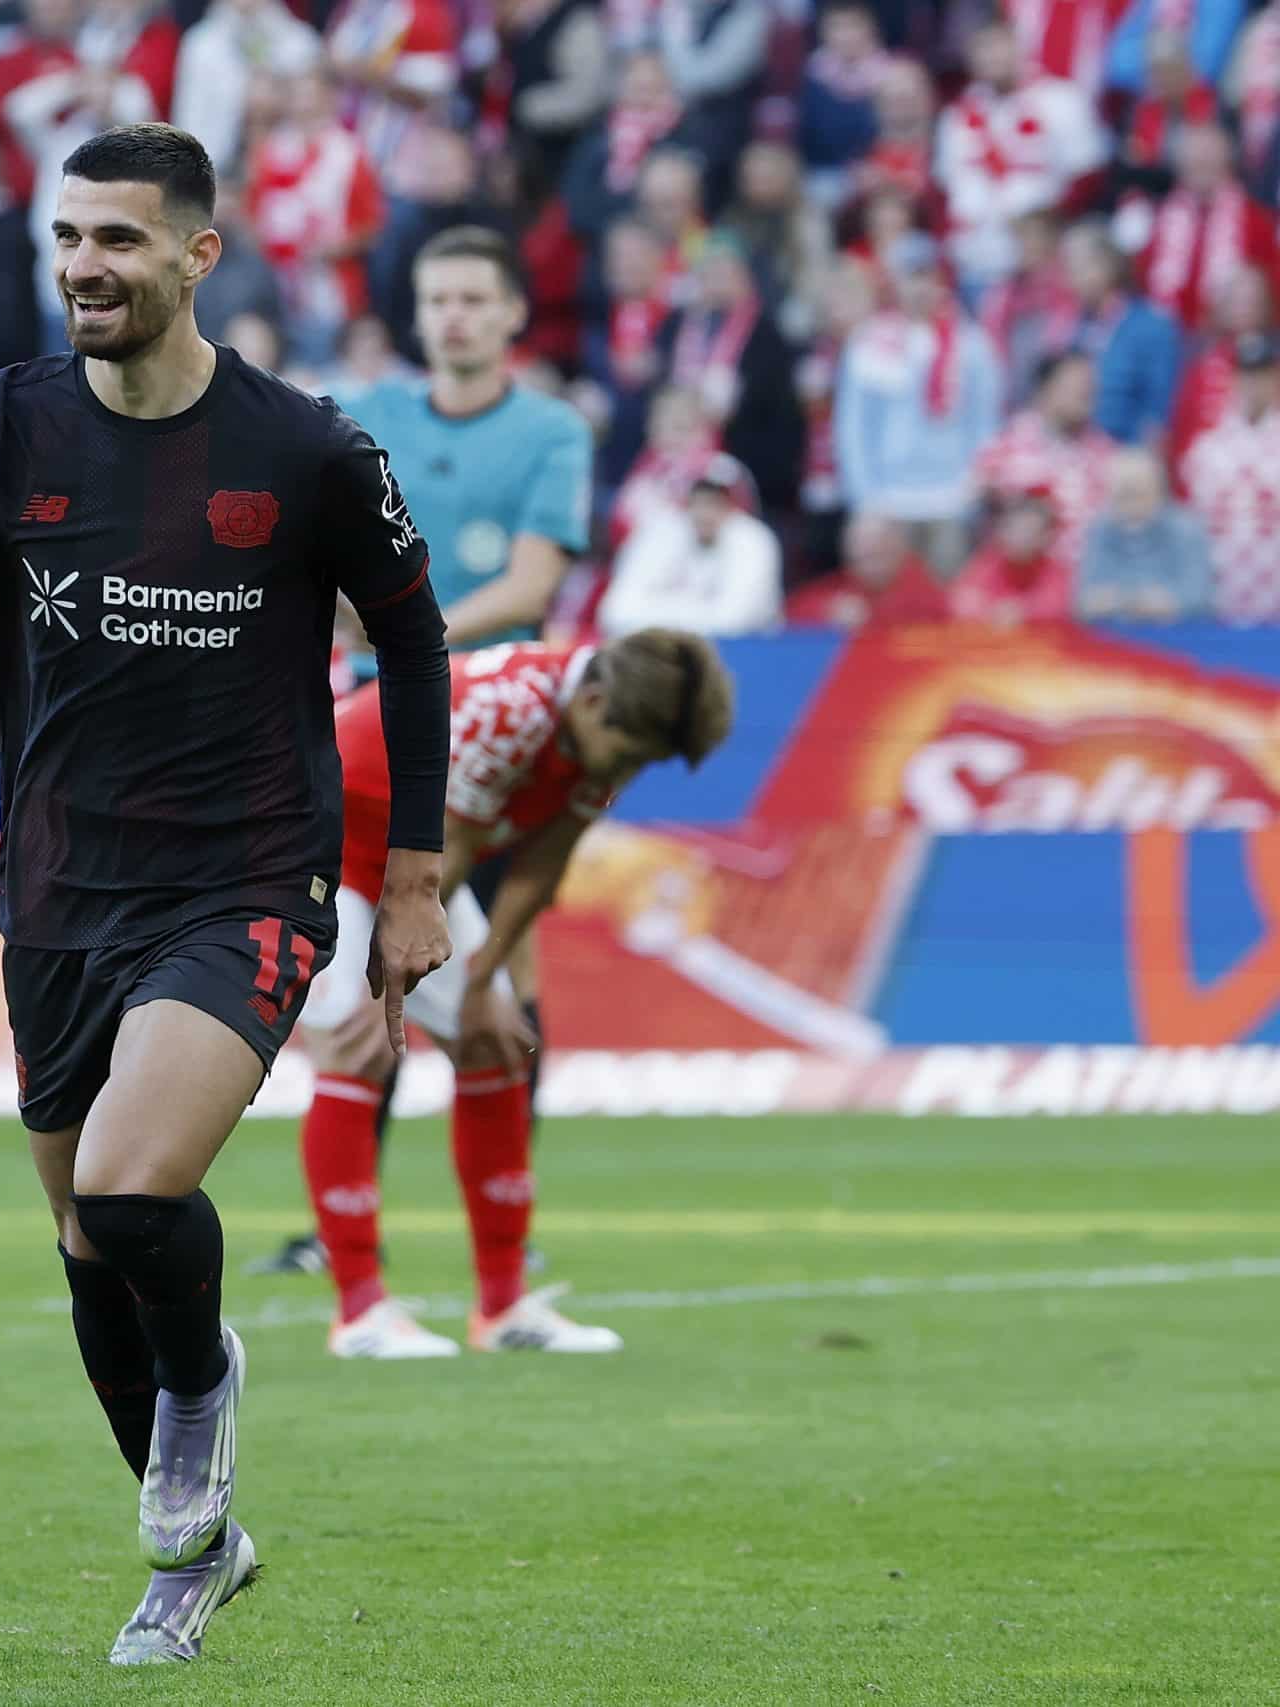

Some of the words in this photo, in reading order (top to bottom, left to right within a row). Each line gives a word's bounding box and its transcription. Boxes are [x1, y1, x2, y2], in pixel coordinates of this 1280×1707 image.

[103, 575, 264, 613] Barmenia
[100, 613, 241, 649] Gothaer
[248, 916, 315, 1013] 11
